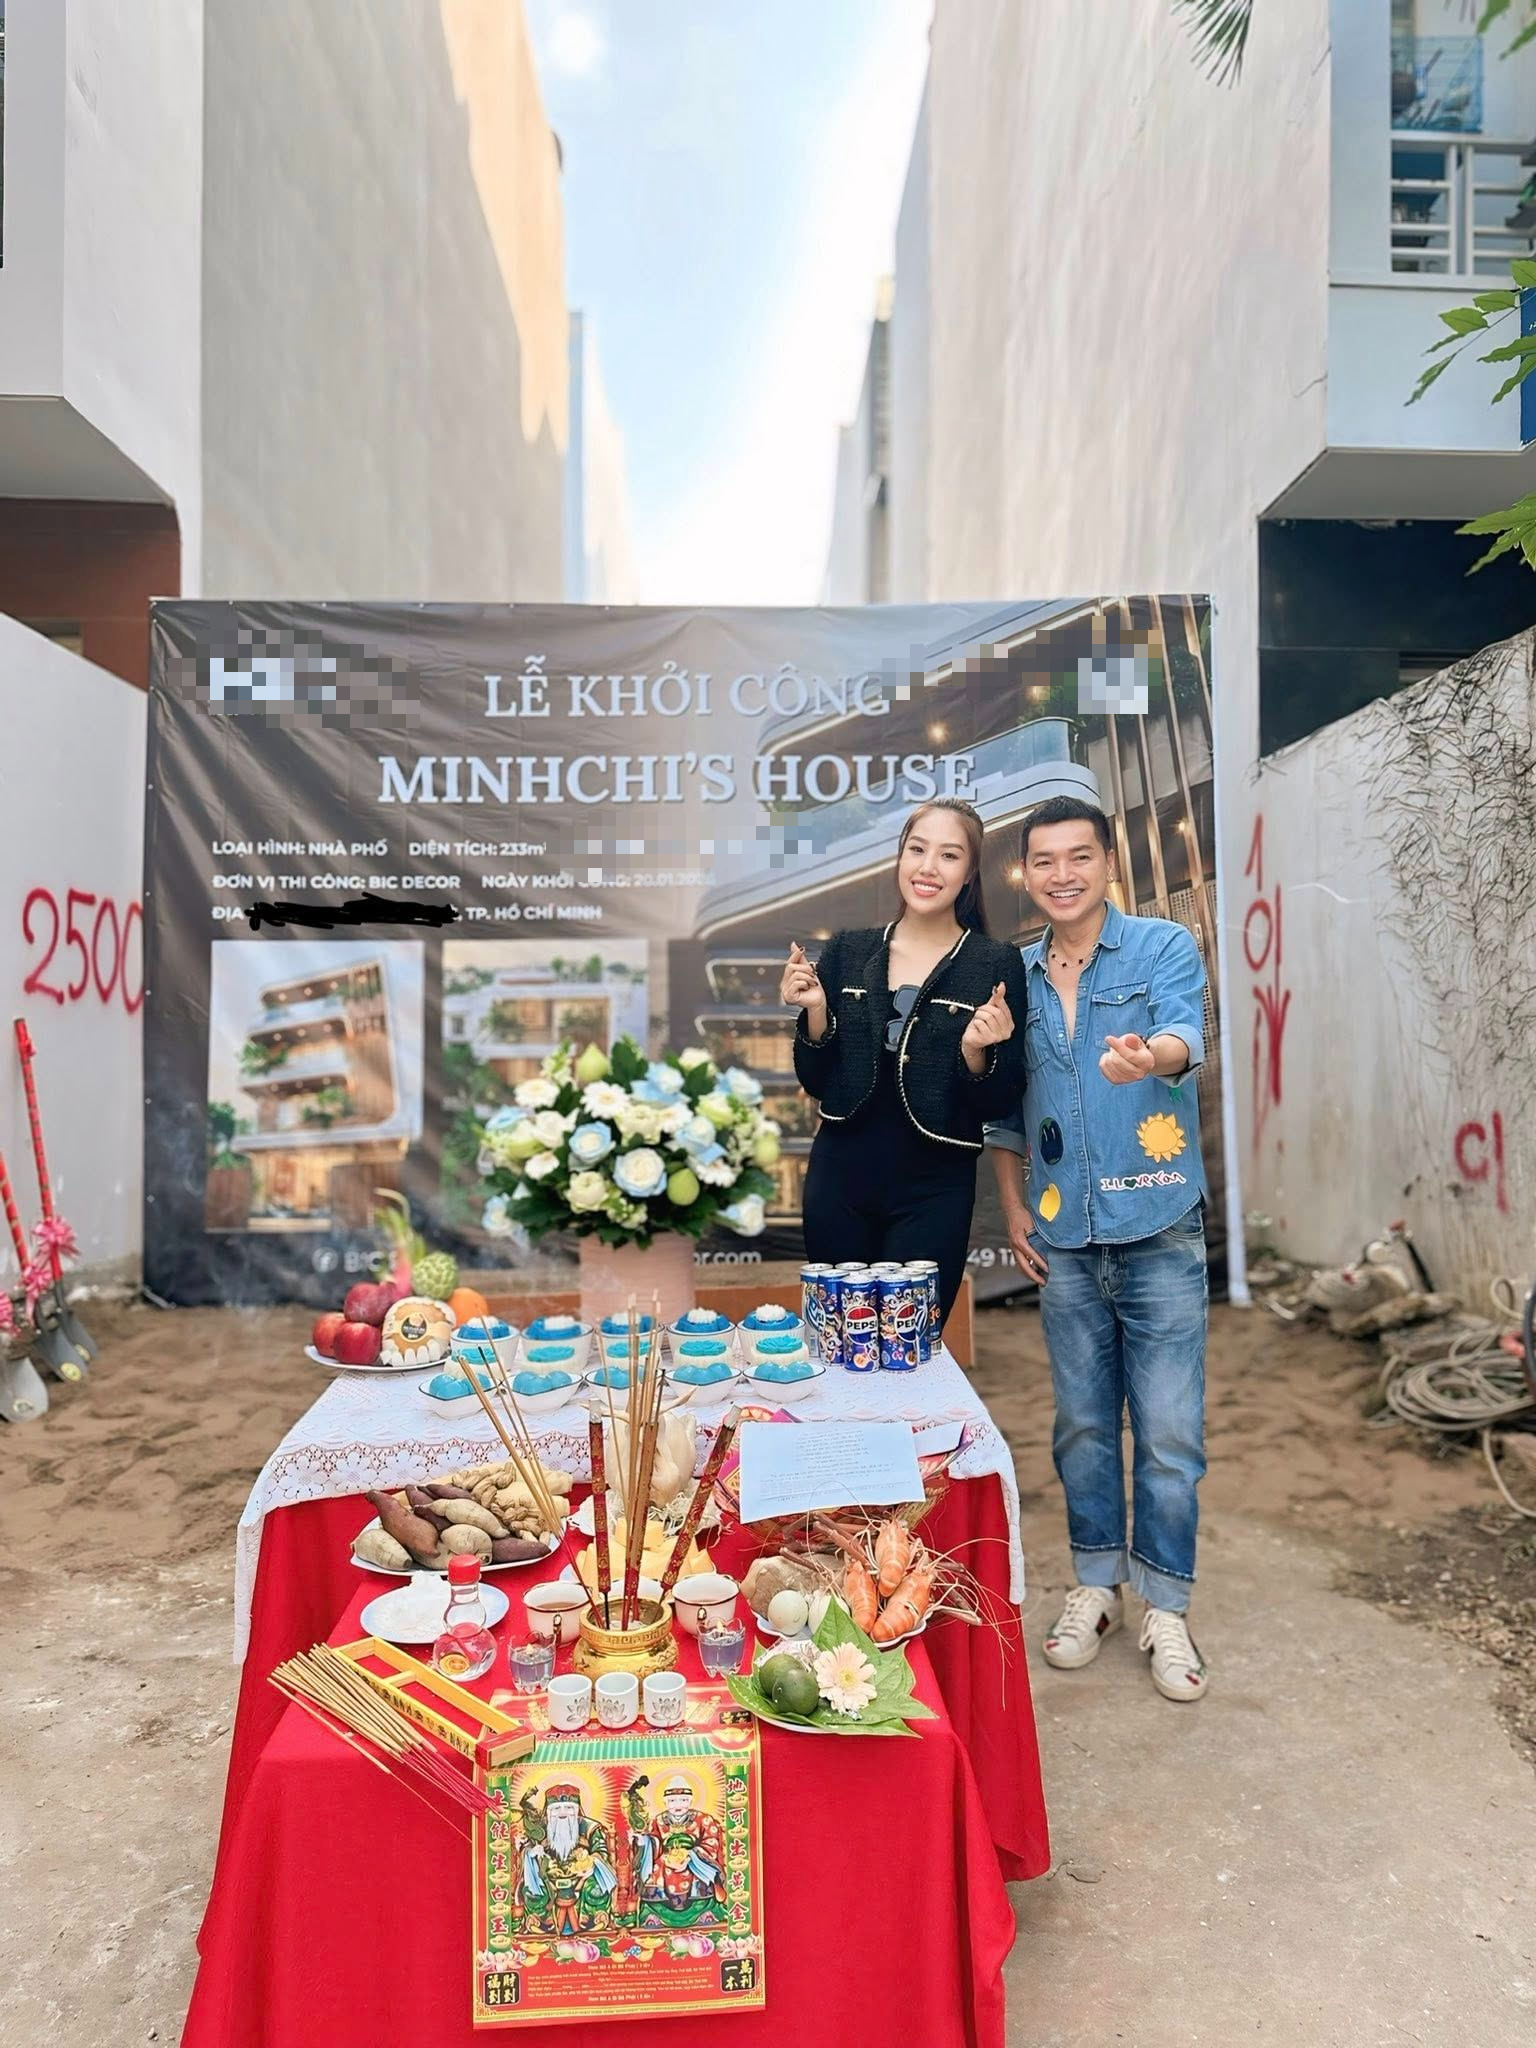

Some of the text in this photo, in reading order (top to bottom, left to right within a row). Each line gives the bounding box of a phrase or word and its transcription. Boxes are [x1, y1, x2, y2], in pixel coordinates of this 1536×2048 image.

[484, 656, 891, 718] LỄ KHỞI CÔNG
[754, 752, 979, 804] HOUSE
[212, 841, 253, 858] LOẠI
[257, 838, 306, 856] HÌNH:
[308, 839, 347, 857] NHÀ
[351, 838, 388, 857] PHỐ
[409, 841, 450, 858] DIỆN
[454, 841, 498, 857] TÍCH:
[212, 874, 253, 889] ĐƠN
[257, 876, 275, 891] VỊ
[279, 876, 307, 889] THI
[310, 872, 366, 890] CÔNG:
[369, 876, 398, 889] BIC
[402, 876, 461, 889] DECOR
[482, 873, 528, 889] NGÀY
[212, 905, 245, 922] ĐỊA
[466, 906, 491, 920] TP.
[524, 902, 554, 920] CHÍ
[557, 905, 602, 920] MINH
[22, 887, 144, 1016] 2500
